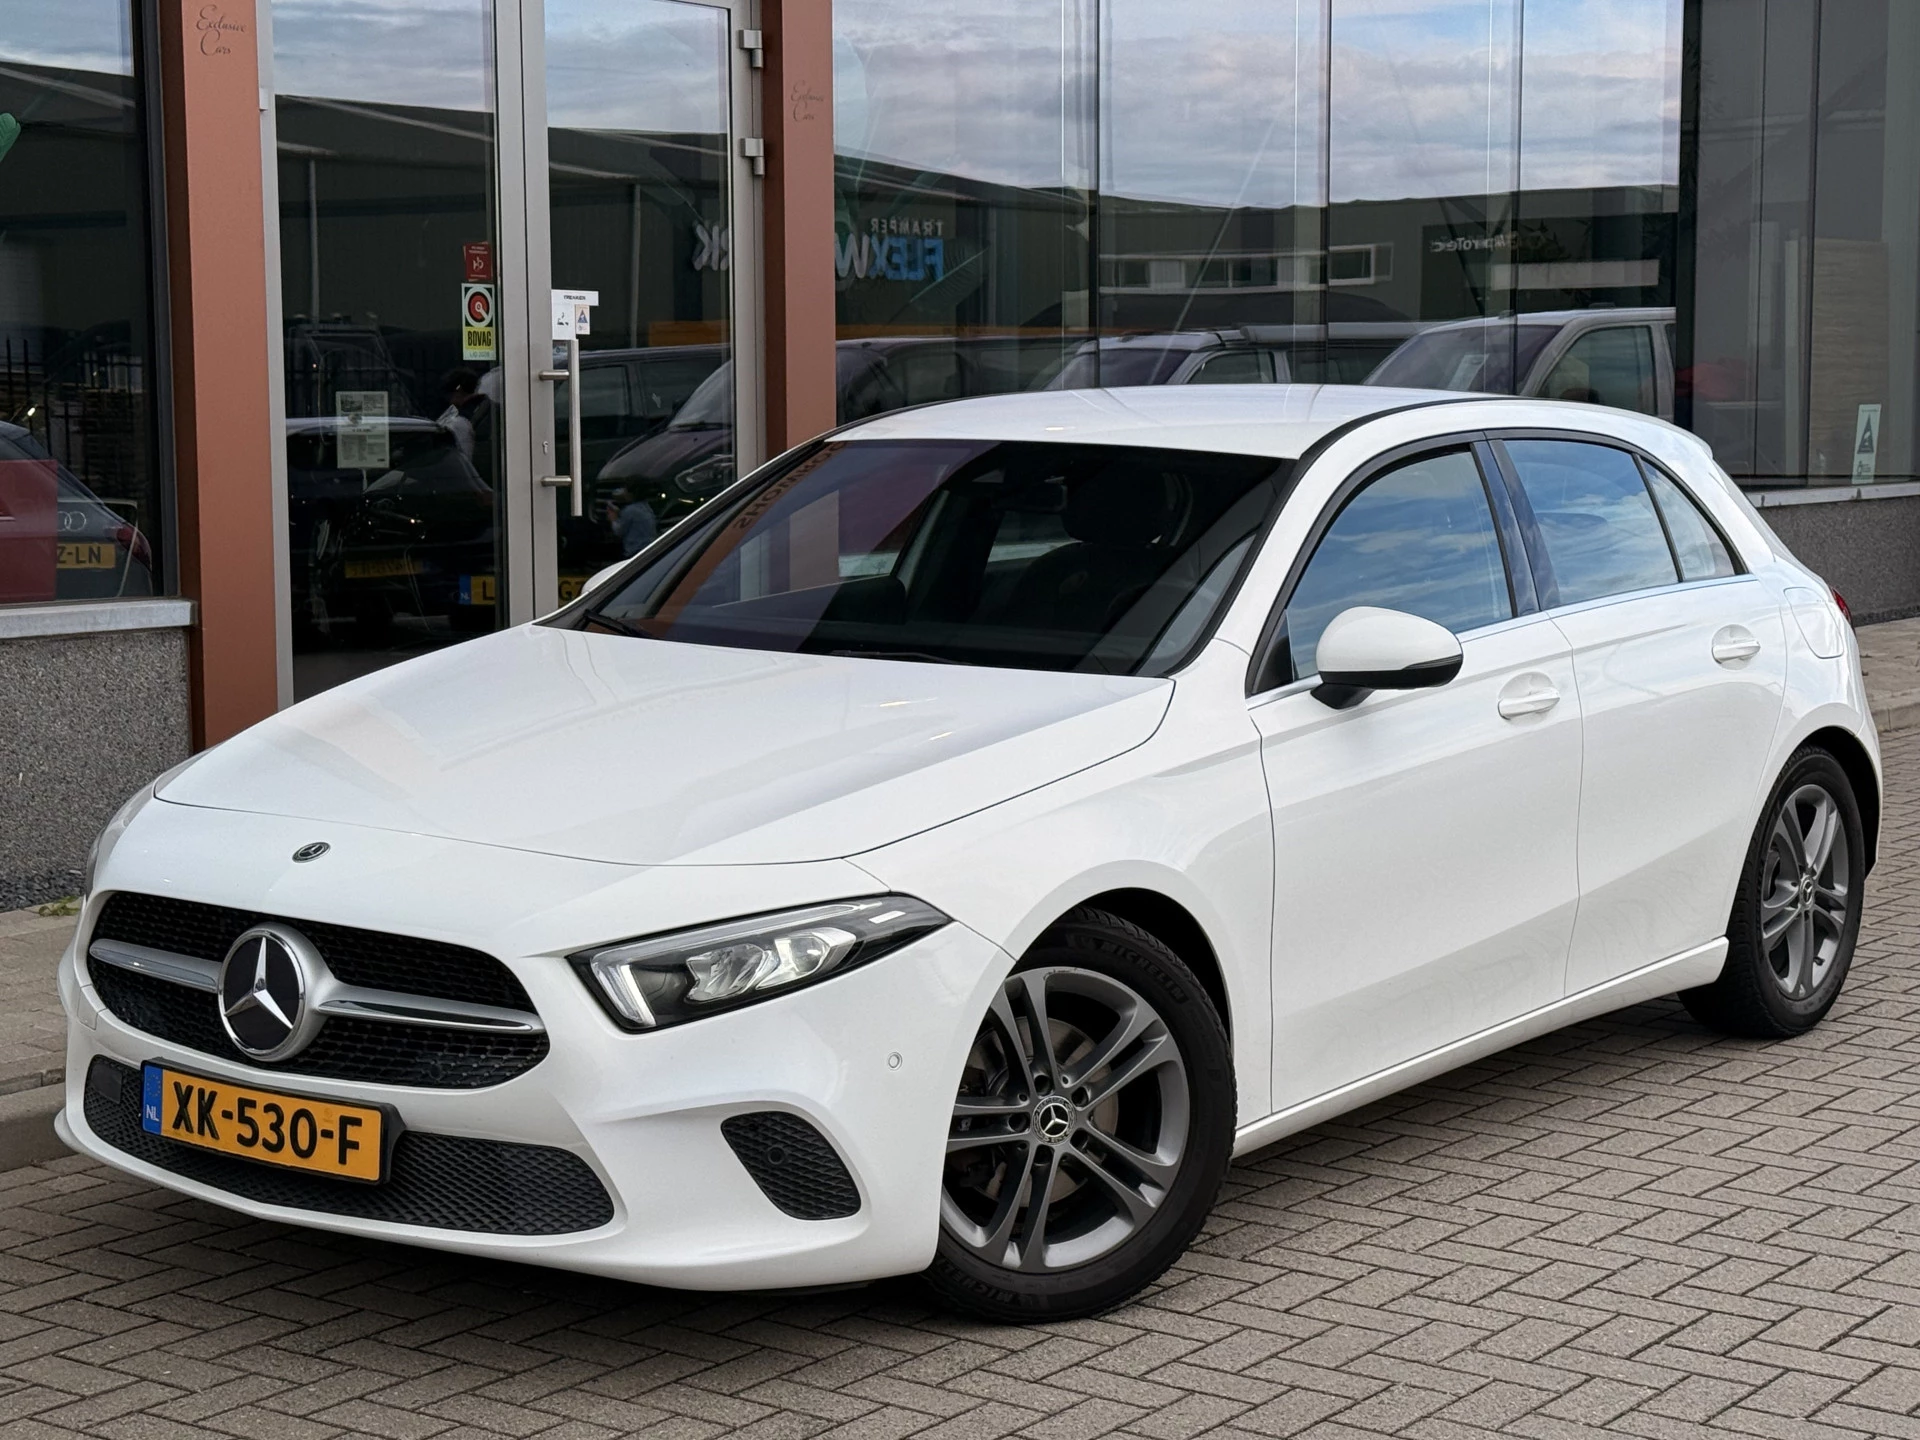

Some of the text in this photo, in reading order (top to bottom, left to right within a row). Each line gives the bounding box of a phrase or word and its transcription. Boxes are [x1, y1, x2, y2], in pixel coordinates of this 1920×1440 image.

[196, 4, 246, 33] Exclusive
[200, 28, 231, 56] Cars
[467, 331, 492, 346] BOVAG
[146, 1104, 160, 1122] NL
[172, 1080, 363, 1165] XK-530-F
